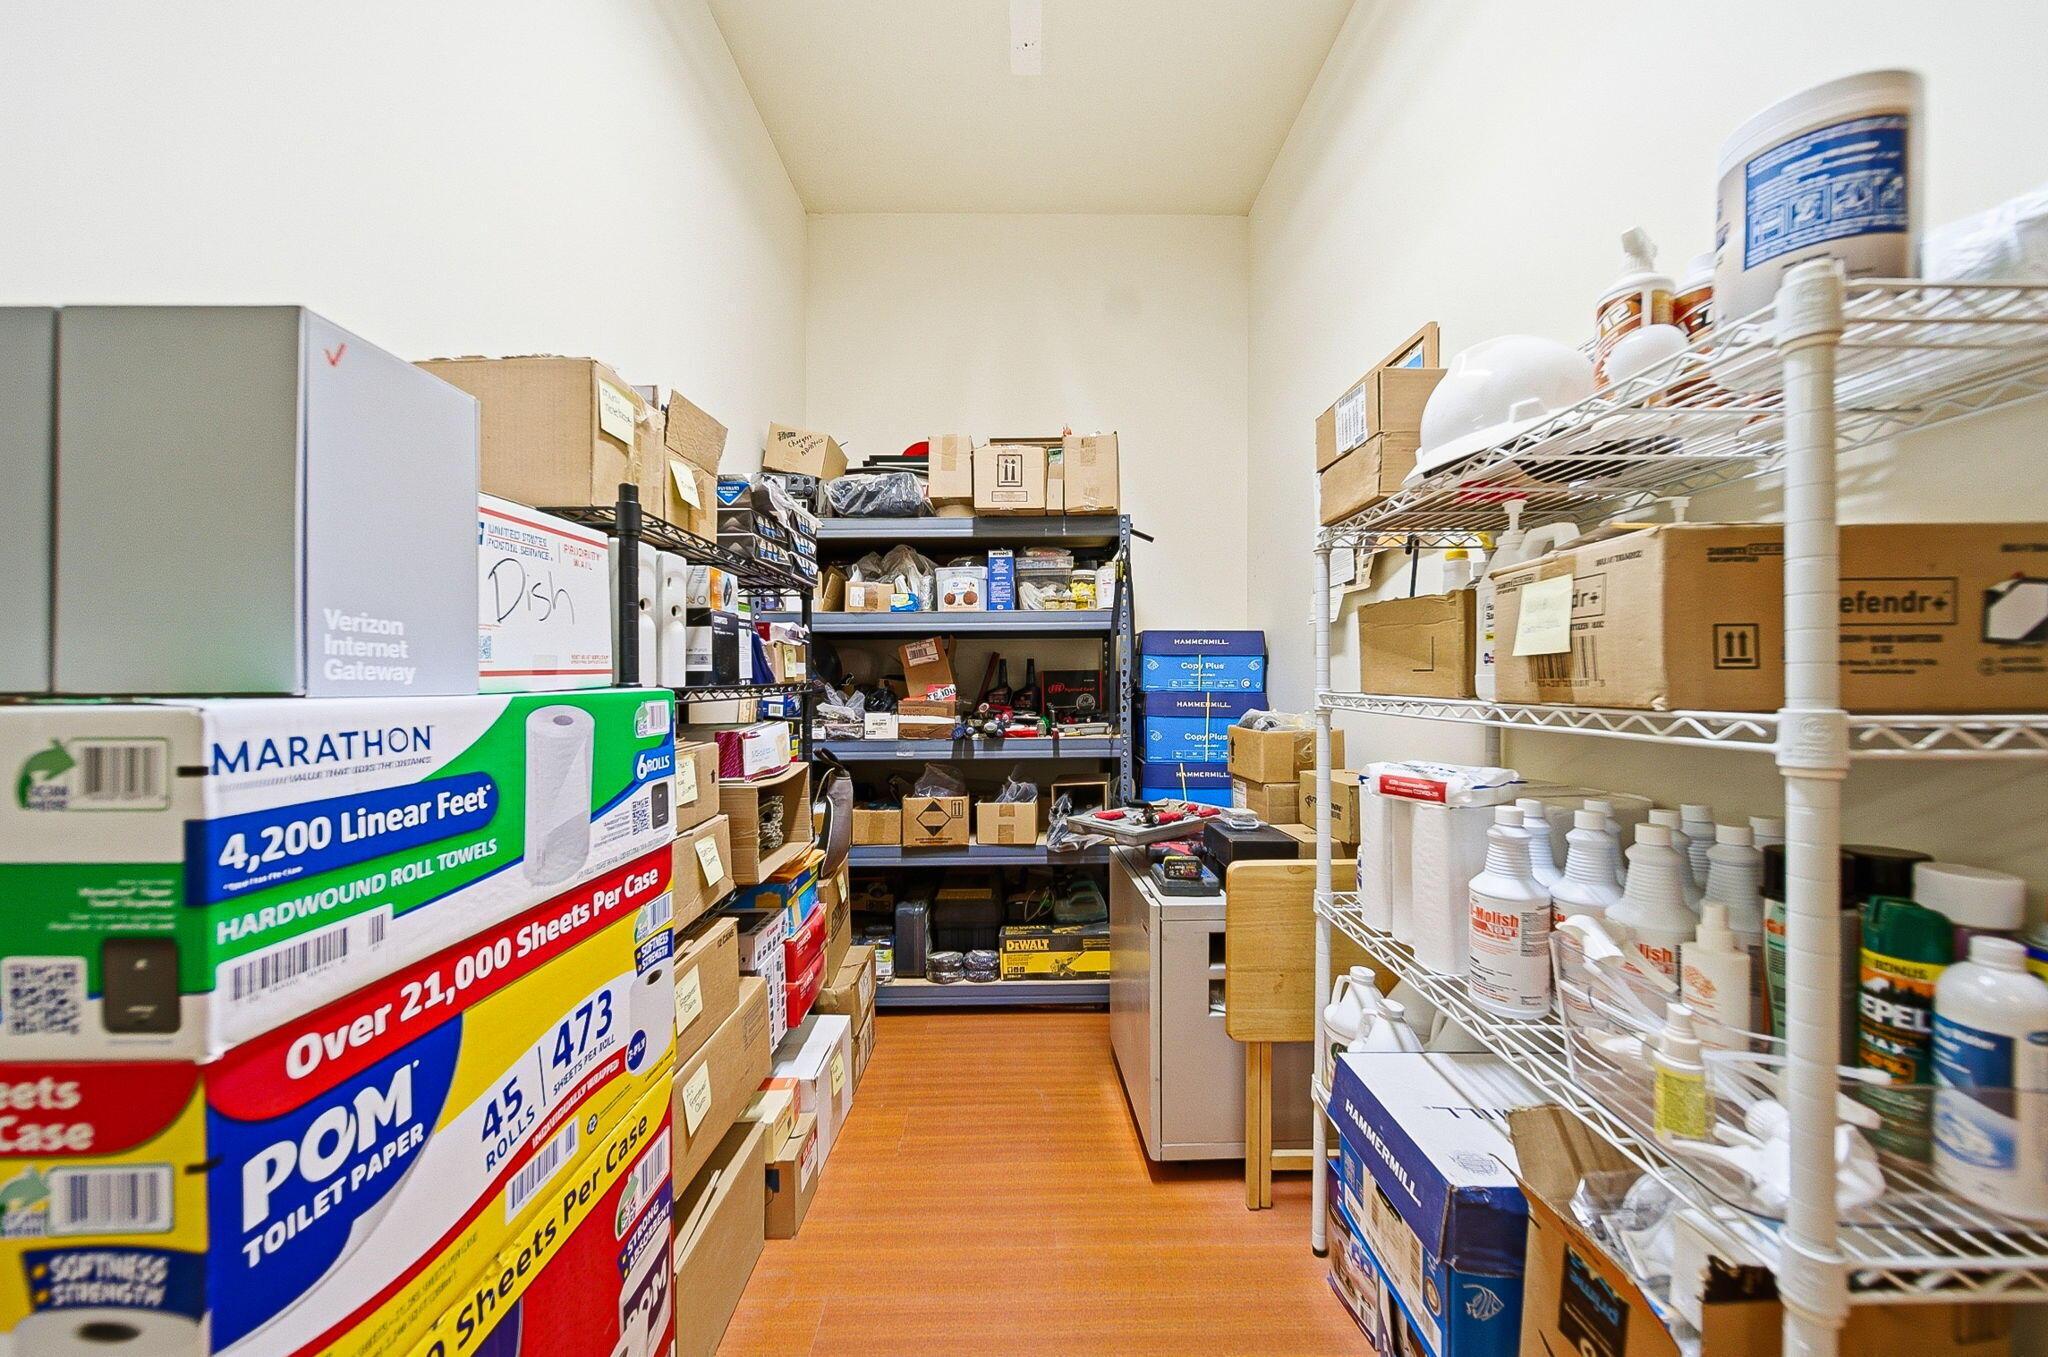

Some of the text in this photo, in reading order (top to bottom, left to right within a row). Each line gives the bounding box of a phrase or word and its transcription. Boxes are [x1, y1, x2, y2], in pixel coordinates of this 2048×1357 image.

[487, 538, 519, 554] POSTAL
[488, 524, 548, 547] UNITED STATES
[562, 543, 602, 561] PRIORITY
[573, 559, 593, 570] MAIL
[488, 557, 575, 625] Dish
[1839, 589, 1948, 614] efendr+
[323, 607, 404, 636] Verizon
[324, 633, 409, 660] Internet
[1181, 661, 1225, 671] Copy Plus
[323, 657, 416, 686] Gateway
[210, 725, 434, 776] MARATHON
[1184, 733, 1206, 742] Copy
[637, 753, 670, 780] 6 ROLLS
[218, 816, 332, 874] 4,200
[340, 800, 432, 843] Linear
[216, 873, 387, 946] HARDWOUND
[391, 858, 434, 889] ROLL
[436, 837, 497, 871] TOWELS
[286, 867, 659, 1081] Over 21,000 Sheets Per Case
[552, 989, 613, 1070] 473
[1860, 991, 1932, 1034] EPEL
[553, 1062, 583, 1096] SHEETS
[584, 1049, 597, 1067] PER
[481, 1075, 524, 1143] 45
[242, 1067, 414, 1235] POM
[485, 1104, 536, 1173] ROLLS
[1345, 1098, 1422, 1208] HAMMERMILL
[242, 1121, 424, 1269] TOILET PAPER
[456, 1217, 557, 1351] Sheets
[563, 1166, 601, 1226] Per
[605, 1115, 648, 1174] Case
[627, 1197, 660, 1255] STRONG
